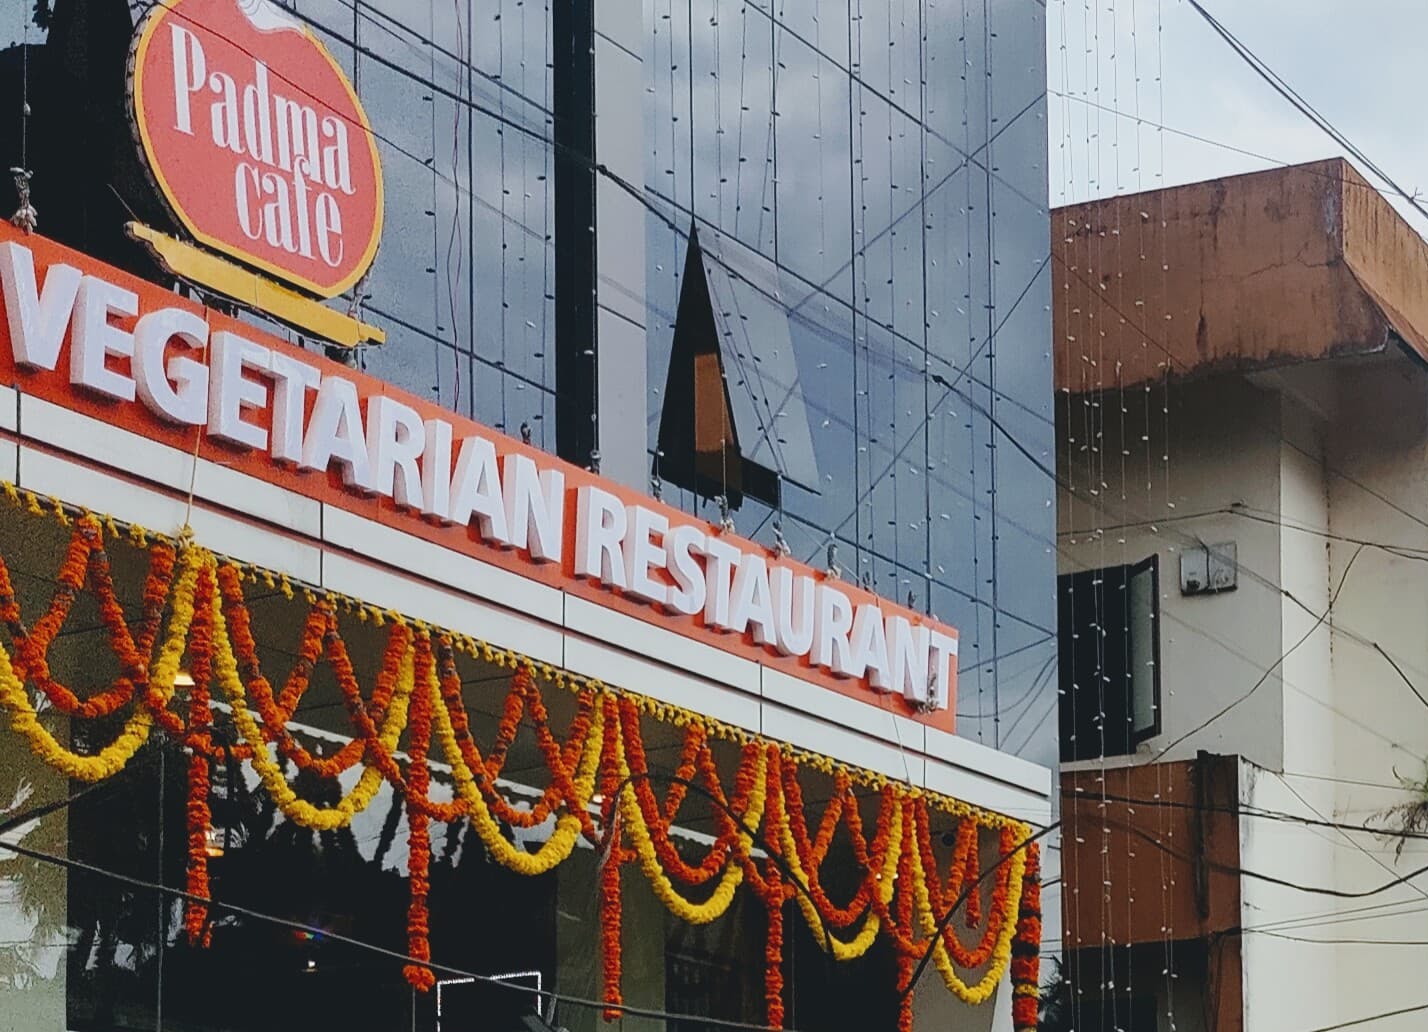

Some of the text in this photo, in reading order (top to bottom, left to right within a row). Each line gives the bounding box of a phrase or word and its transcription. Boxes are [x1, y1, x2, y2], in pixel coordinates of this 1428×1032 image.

[168, 22, 356, 197] Padma
[235, 153, 344, 268] cafe
[2, 241, 565, 564] VEGETARIAN
[576, 485, 956, 712] RESTAURANT
